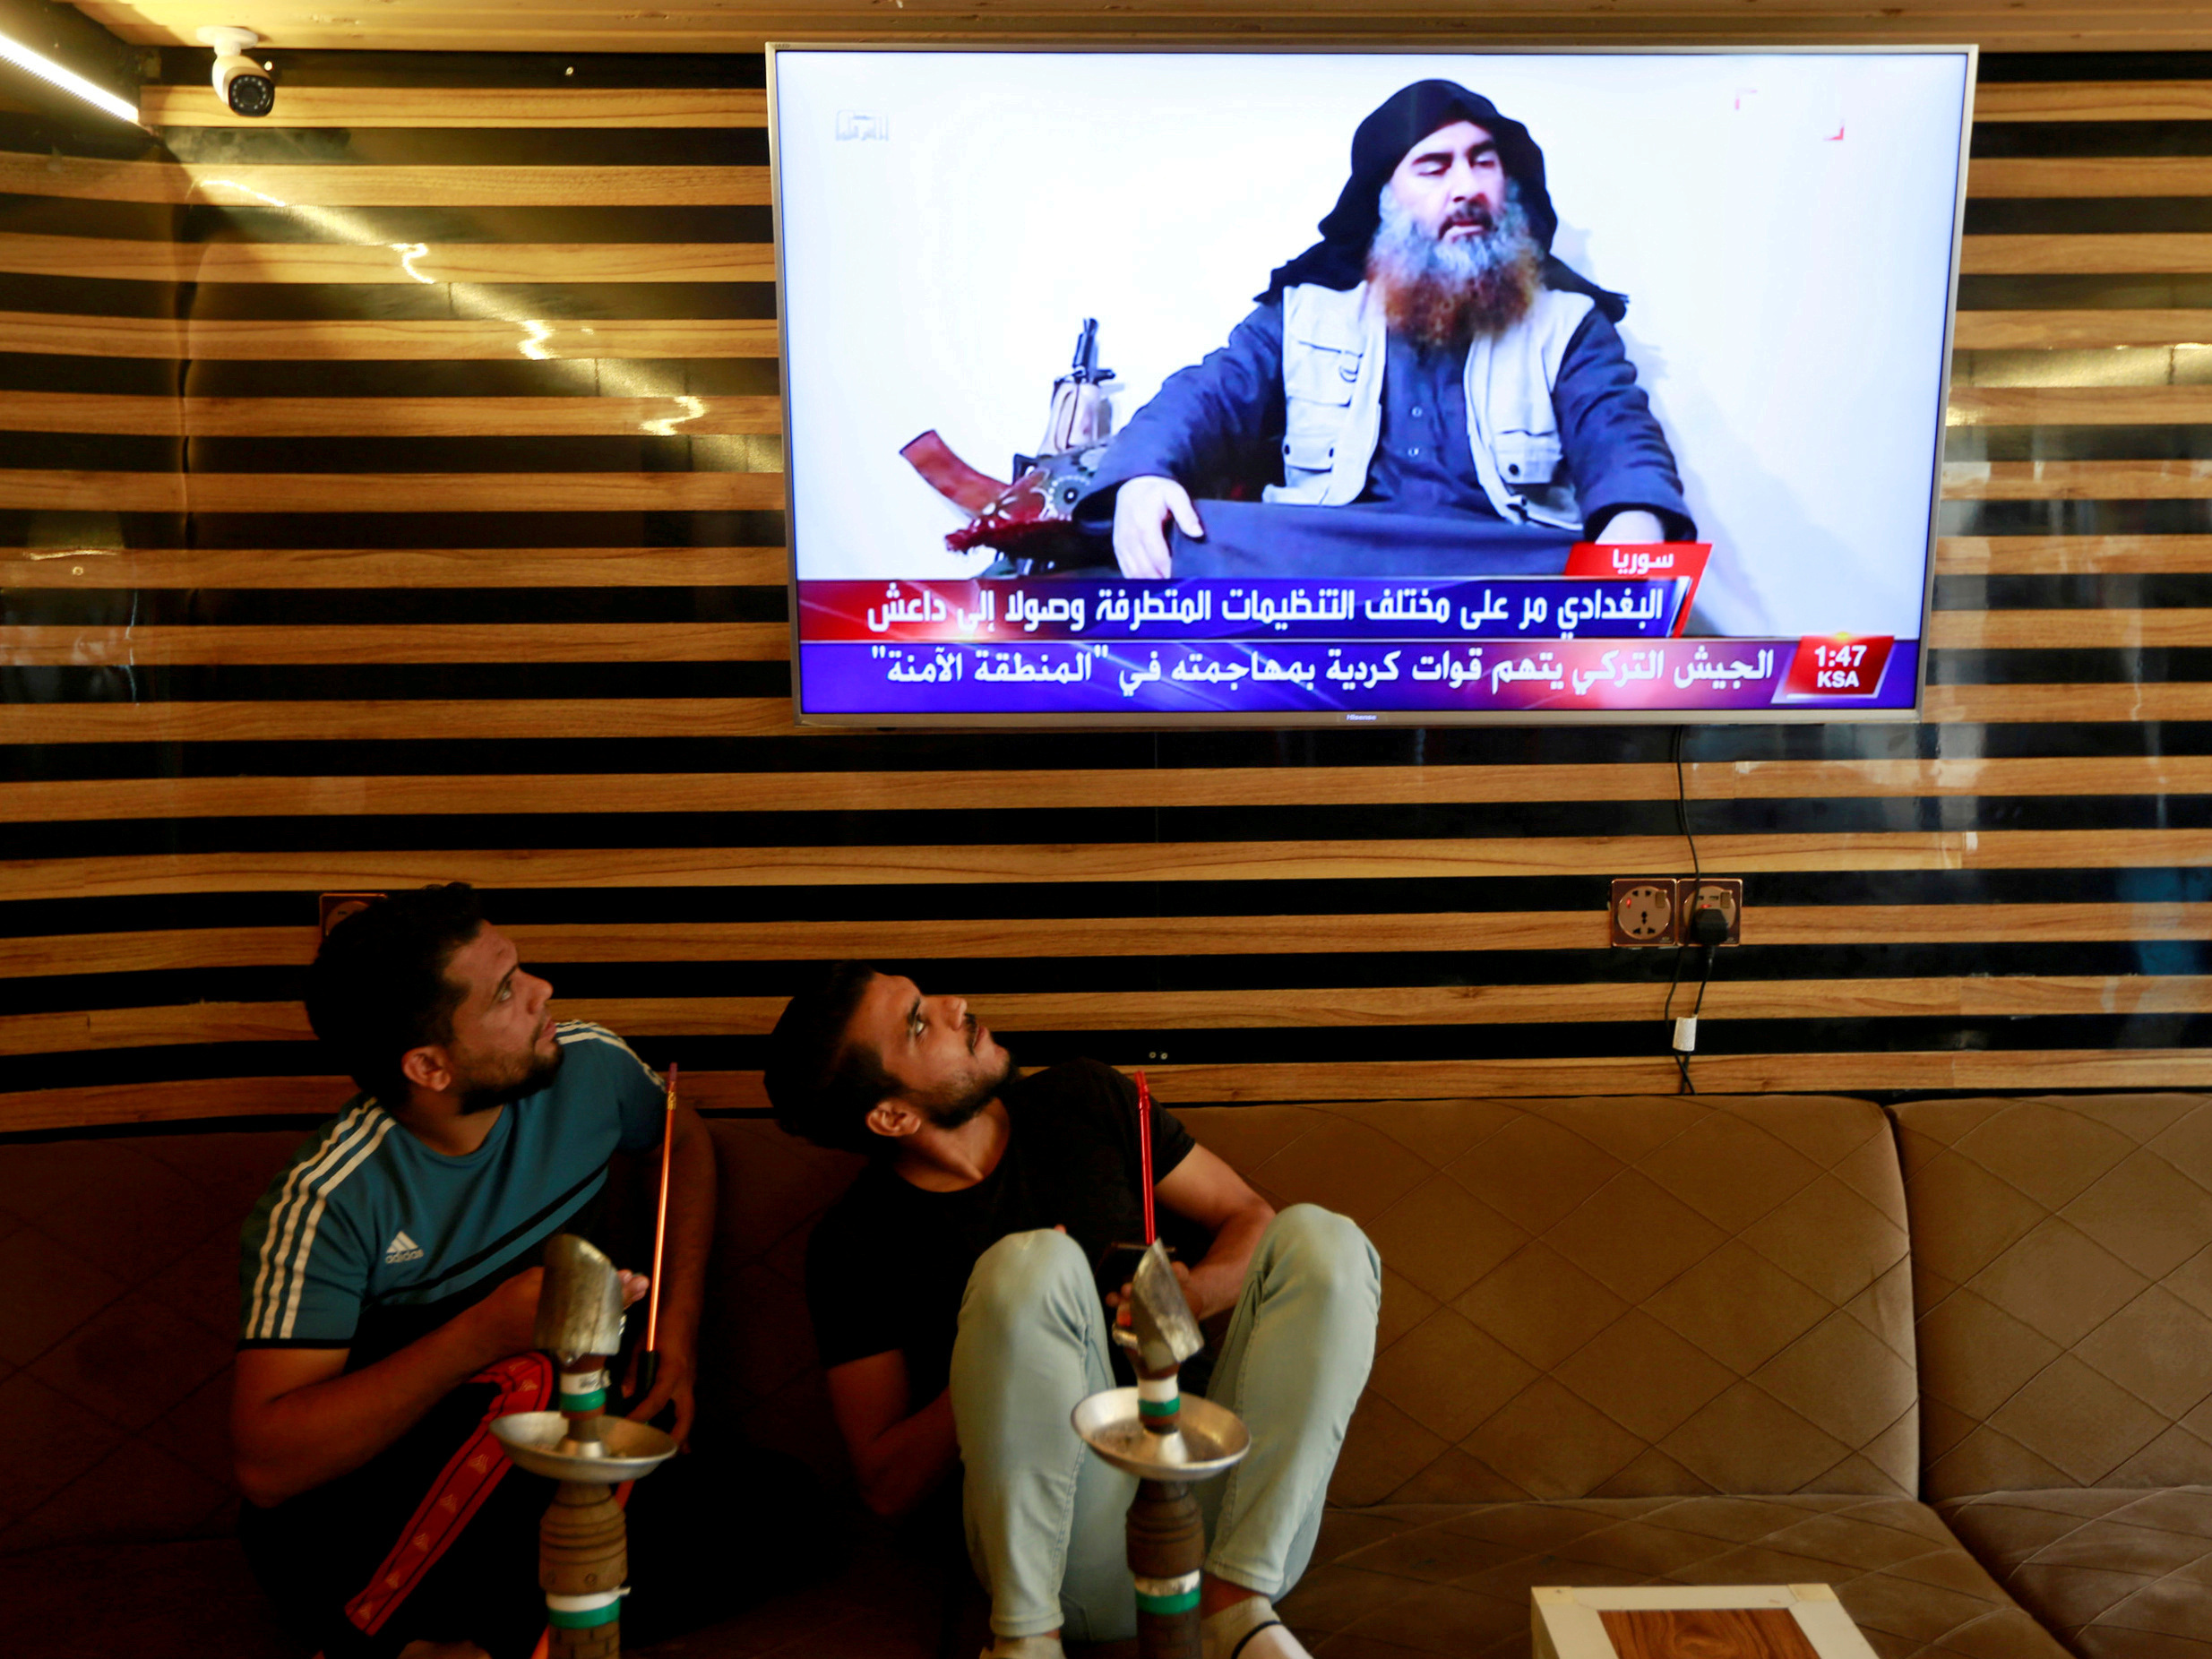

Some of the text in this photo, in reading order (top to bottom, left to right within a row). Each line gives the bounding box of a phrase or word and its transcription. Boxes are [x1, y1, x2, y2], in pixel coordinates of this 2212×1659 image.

[1612, 549, 1674, 574] سوريا
[868, 582, 1664, 640] البغدادي مر على مختلف التنظيمات المتطرفة وصولا إلى داعش
[1119, 650, 1162, 697] في
[1171, 650, 1316, 691] بمهاجمته
[1326, 649, 1401, 690] كردية
[1412, 648, 1483, 689] قوات
[1492, 651, 1564, 693] يتهم
[1571, 649, 1664, 696] التركي
[1673, 643, 1774, 691] الجيش
[1813, 644, 1868, 668] 1:47
[1816, 670, 1862, 689] KSA
